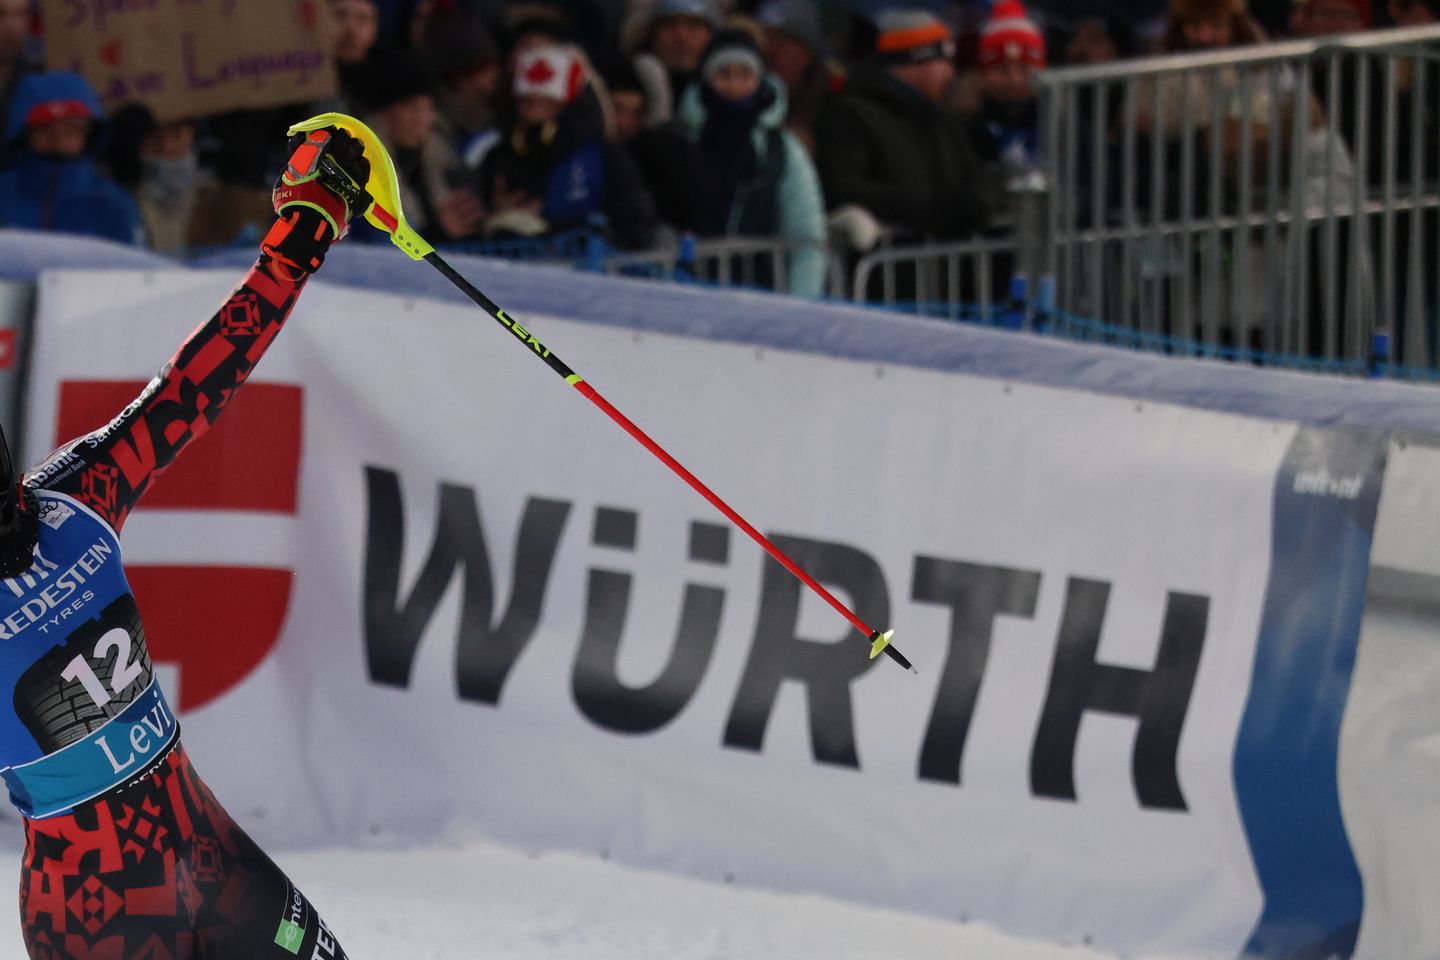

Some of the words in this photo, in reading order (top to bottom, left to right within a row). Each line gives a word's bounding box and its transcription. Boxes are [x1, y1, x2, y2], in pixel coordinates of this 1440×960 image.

[496, 309, 550, 358] LEKI
[37, 589, 96, 635] TYRES
[60, 627, 143, 709] 12
[95, 689, 172, 775] Levi
